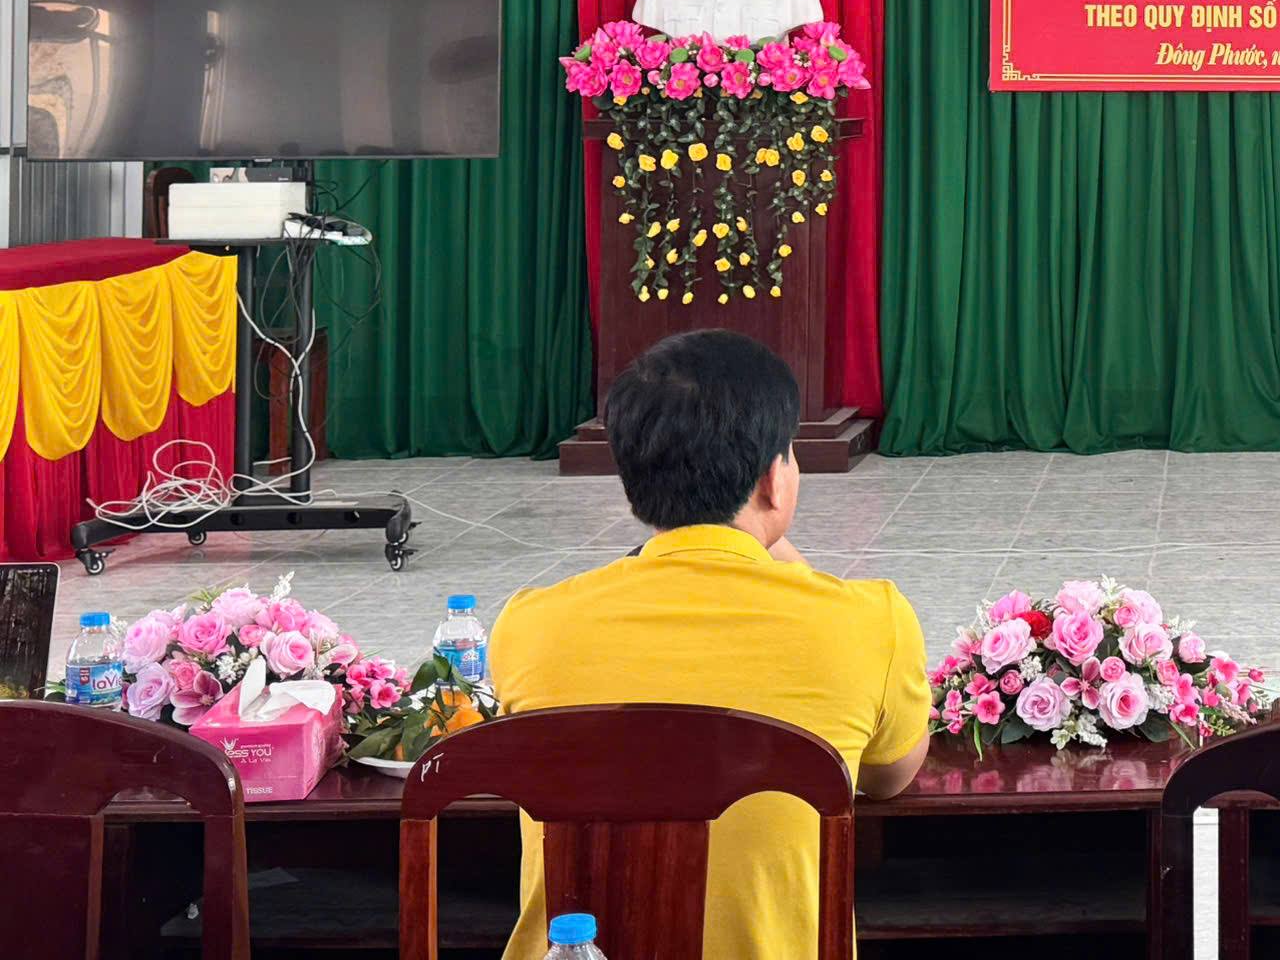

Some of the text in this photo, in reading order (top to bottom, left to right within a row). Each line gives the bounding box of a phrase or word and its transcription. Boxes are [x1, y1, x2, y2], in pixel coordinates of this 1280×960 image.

[1084, 4, 1137, 28] THEO
[1144, 4, 1185, 30] QUY
[1190, 5, 1243, 33] ĐỊNH
[1155, 42, 1206, 72] Đông
[1208, 42, 1268, 69] Phước,
[250, 748, 272, 757] YOU
